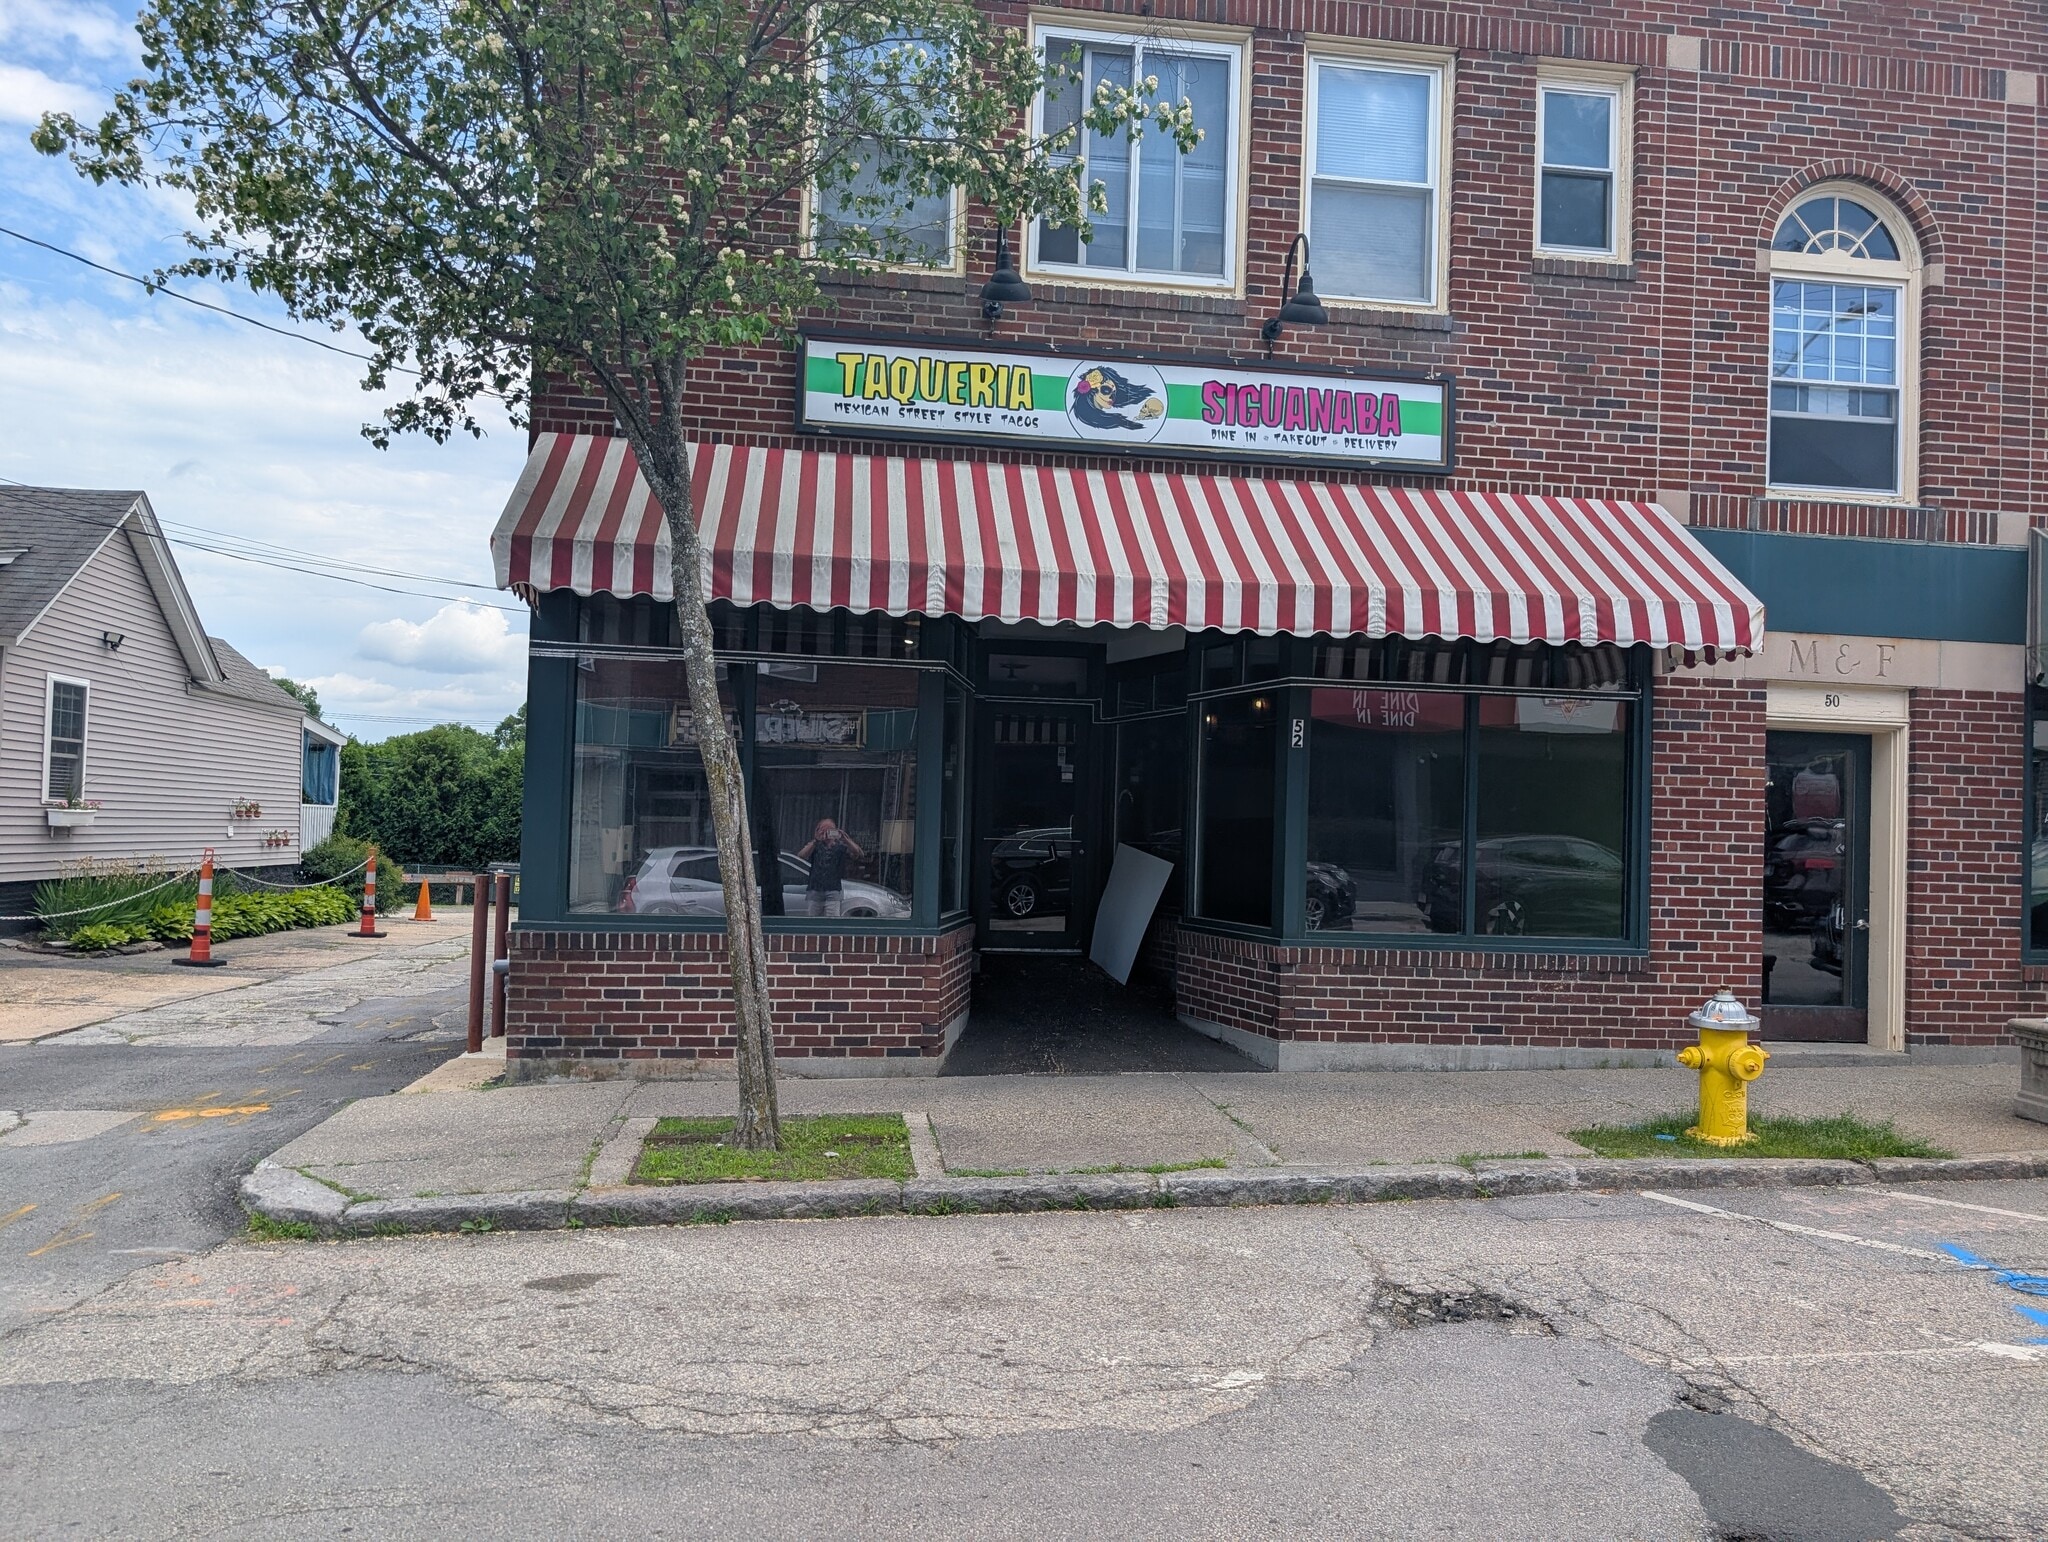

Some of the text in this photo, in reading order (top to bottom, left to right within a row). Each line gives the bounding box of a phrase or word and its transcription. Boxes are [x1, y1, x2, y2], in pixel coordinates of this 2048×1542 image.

[836, 352, 1034, 410] TAQUERIA
[834, 402, 1039, 429] MEXICAN STREET STYLE TACOS
[1201, 380, 1401, 437] SIGUANABA
[1211, 429, 1397, 451] DINE IN TAKEOUT DELIVERY
[1789, 640, 1896, 677] M & F
[1825, 694, 1840, 708] 50
[1293, 720, 1303, 747] 52
